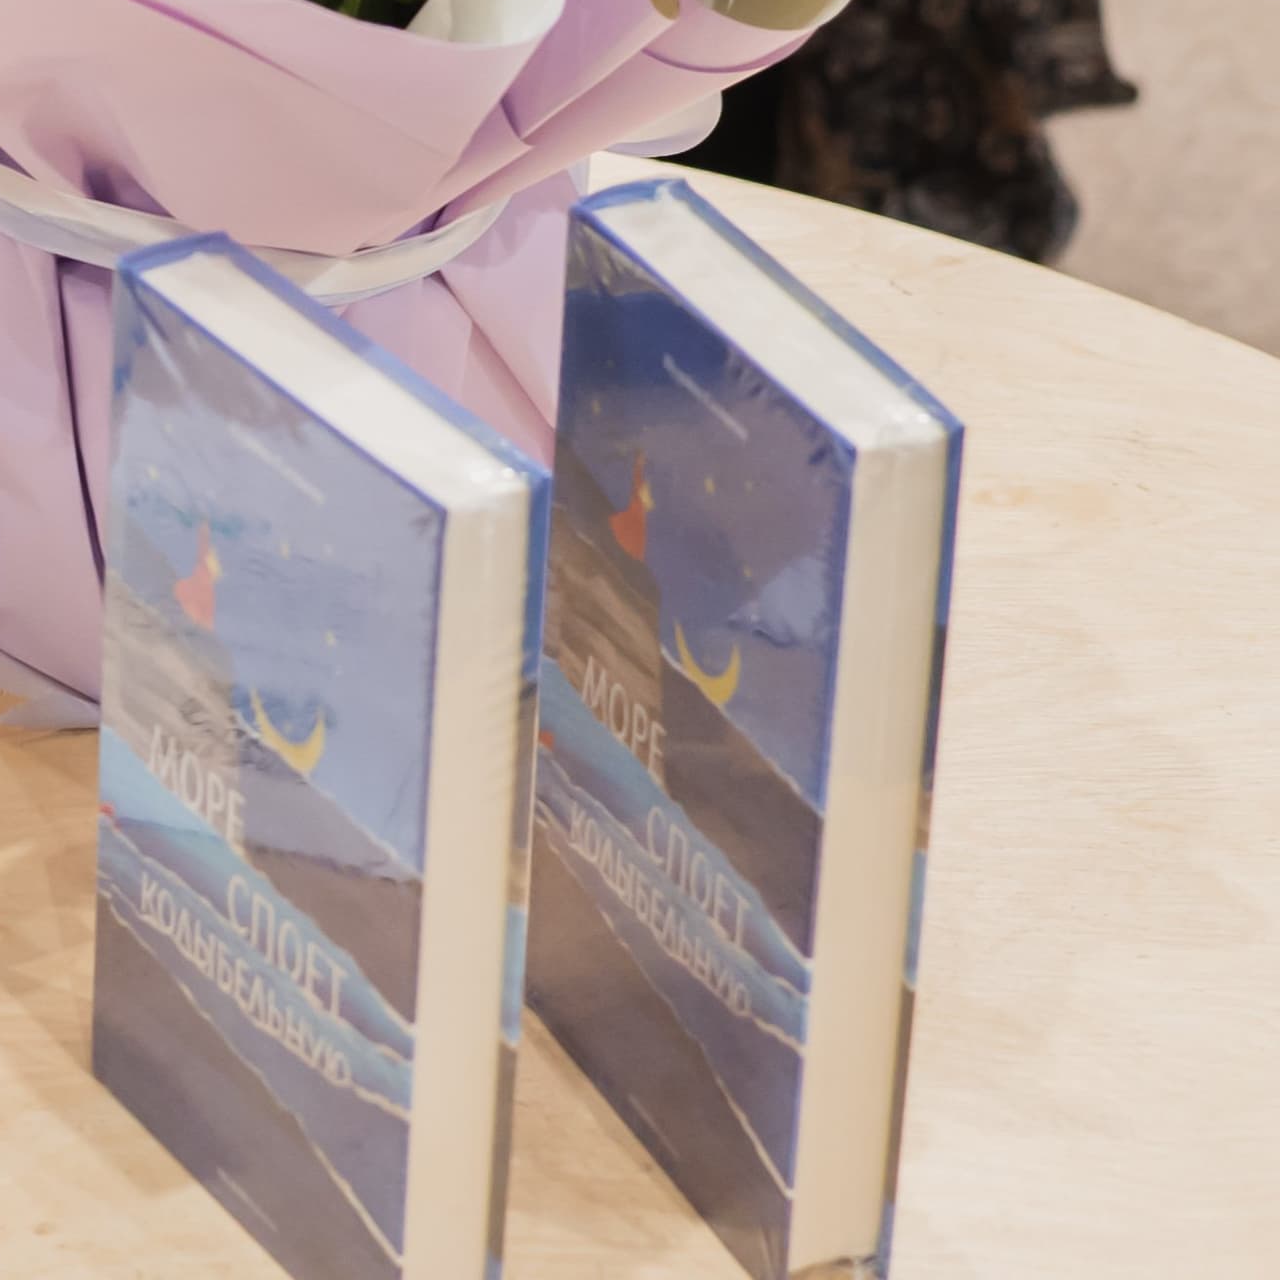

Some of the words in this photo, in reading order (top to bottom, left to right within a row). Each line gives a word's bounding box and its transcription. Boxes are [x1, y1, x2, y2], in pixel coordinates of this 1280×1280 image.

[148, 724, 246, 848] МОРЕ
[582, 656, 667, 776] МОРЕ
[225, 873, 348, 1018] СПОЕТ
[569, 804, 751, 1015] КОЛЫБЕЛЬНУЮ
[646, 805, 748, 945] СПОЕТ
[140, 873, 352, 1088] КОЛЫБЕЛЬНУЮ
